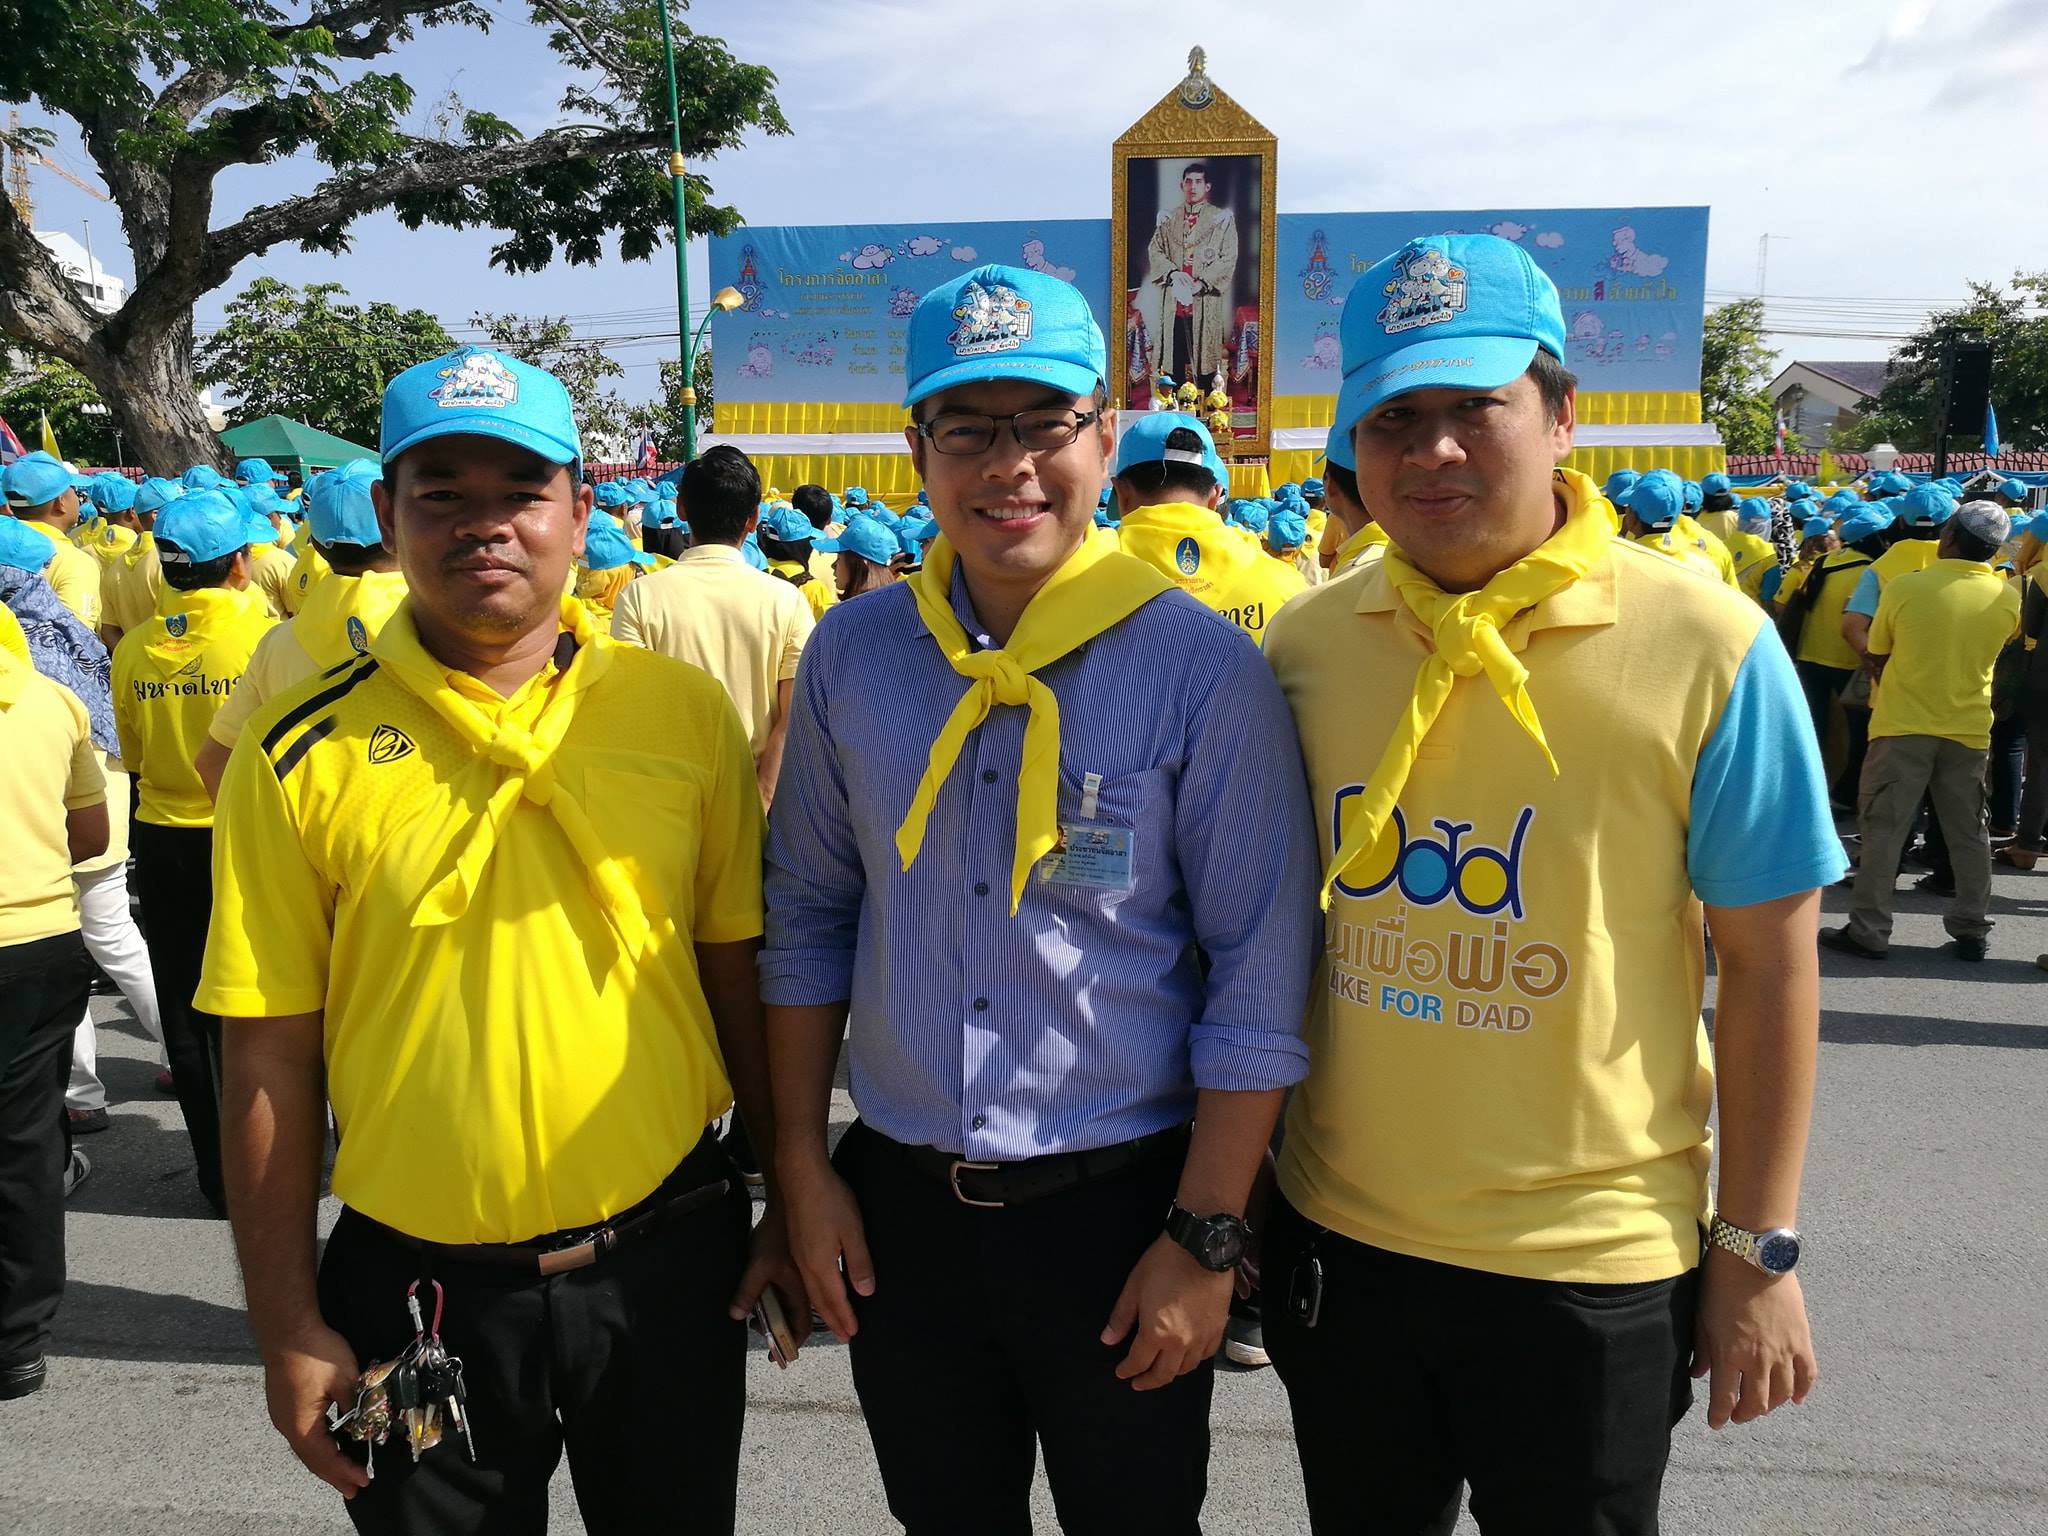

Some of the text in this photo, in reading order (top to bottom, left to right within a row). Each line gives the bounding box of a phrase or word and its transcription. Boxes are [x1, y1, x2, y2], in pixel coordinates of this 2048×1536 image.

[776, 267, 889, 287] โครงการจิตอาสา
[1329, 964, 1533, 1032] IKE FOR DAD
